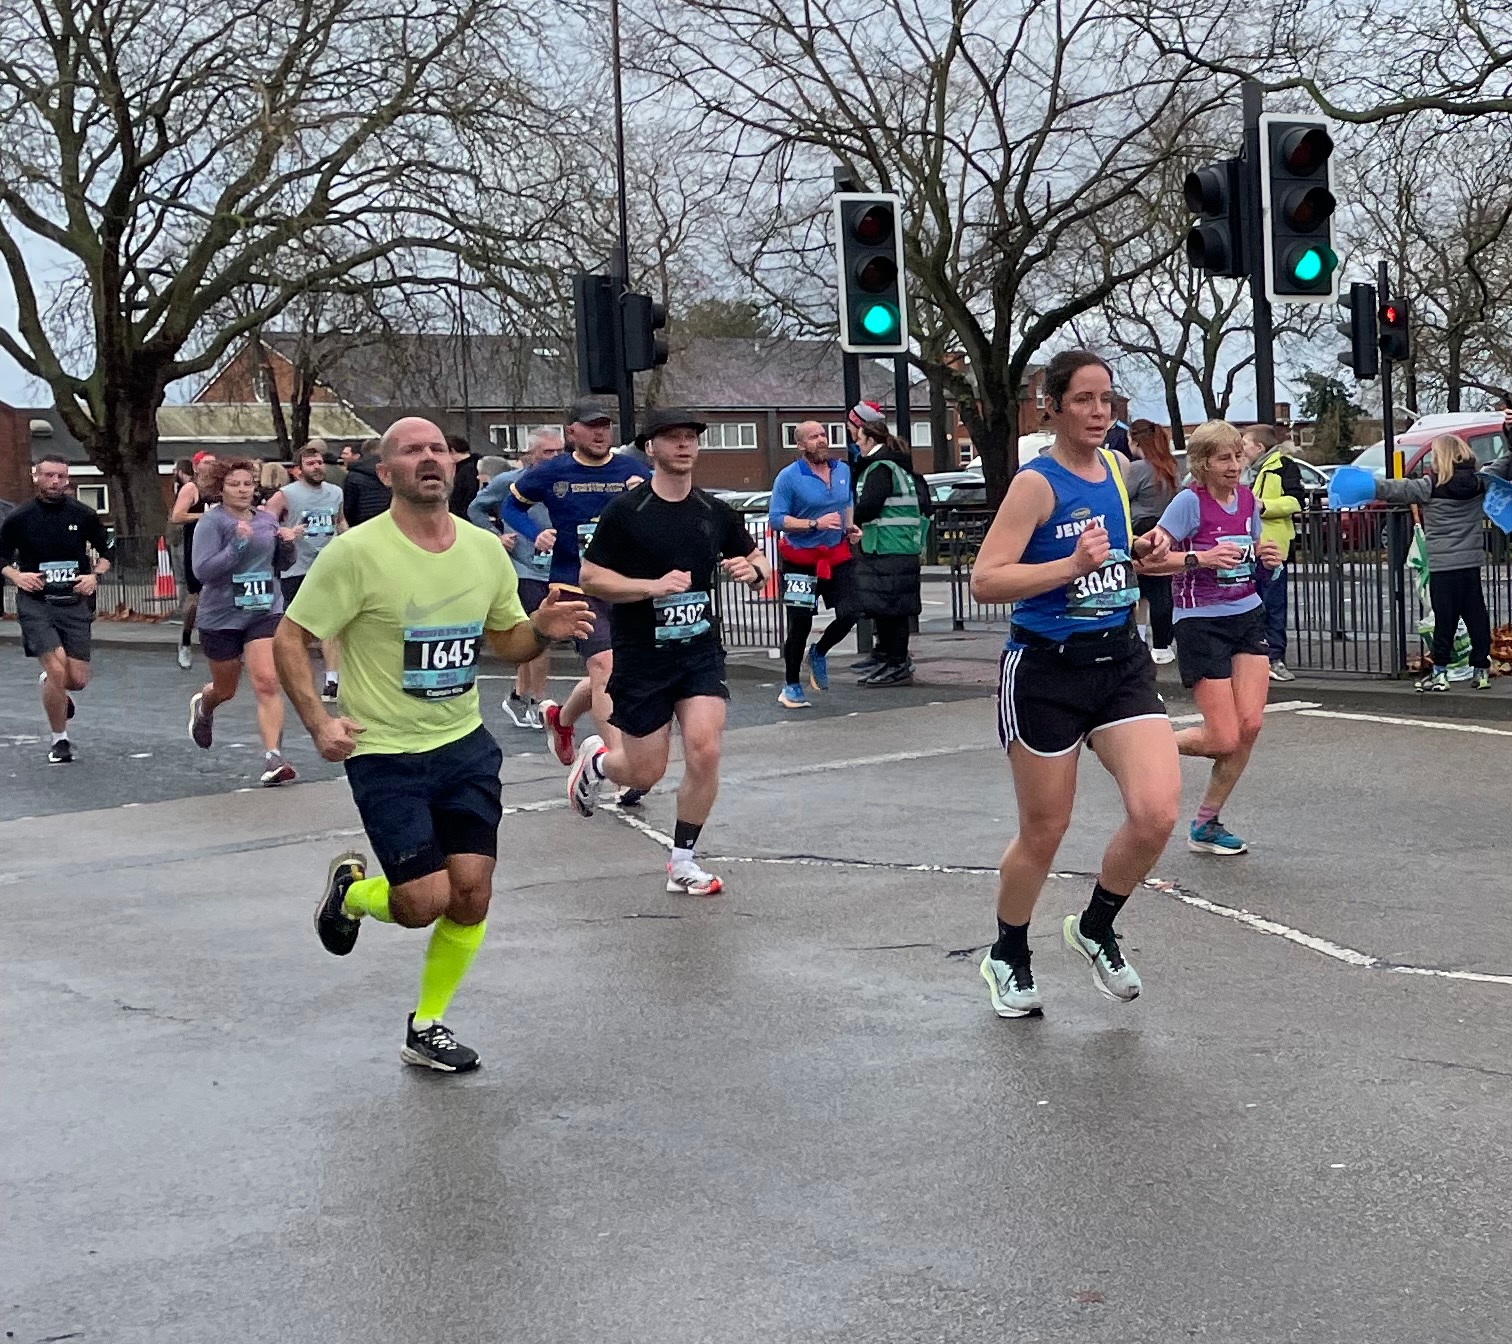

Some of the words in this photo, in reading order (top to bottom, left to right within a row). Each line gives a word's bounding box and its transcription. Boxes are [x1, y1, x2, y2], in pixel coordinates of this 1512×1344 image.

[45, 567, 76, 583] 3025
[1073, 563, 1127, 599] 3049
[663, 603, 705, 626] 2502
[421, 638, 476, 670] 1645
